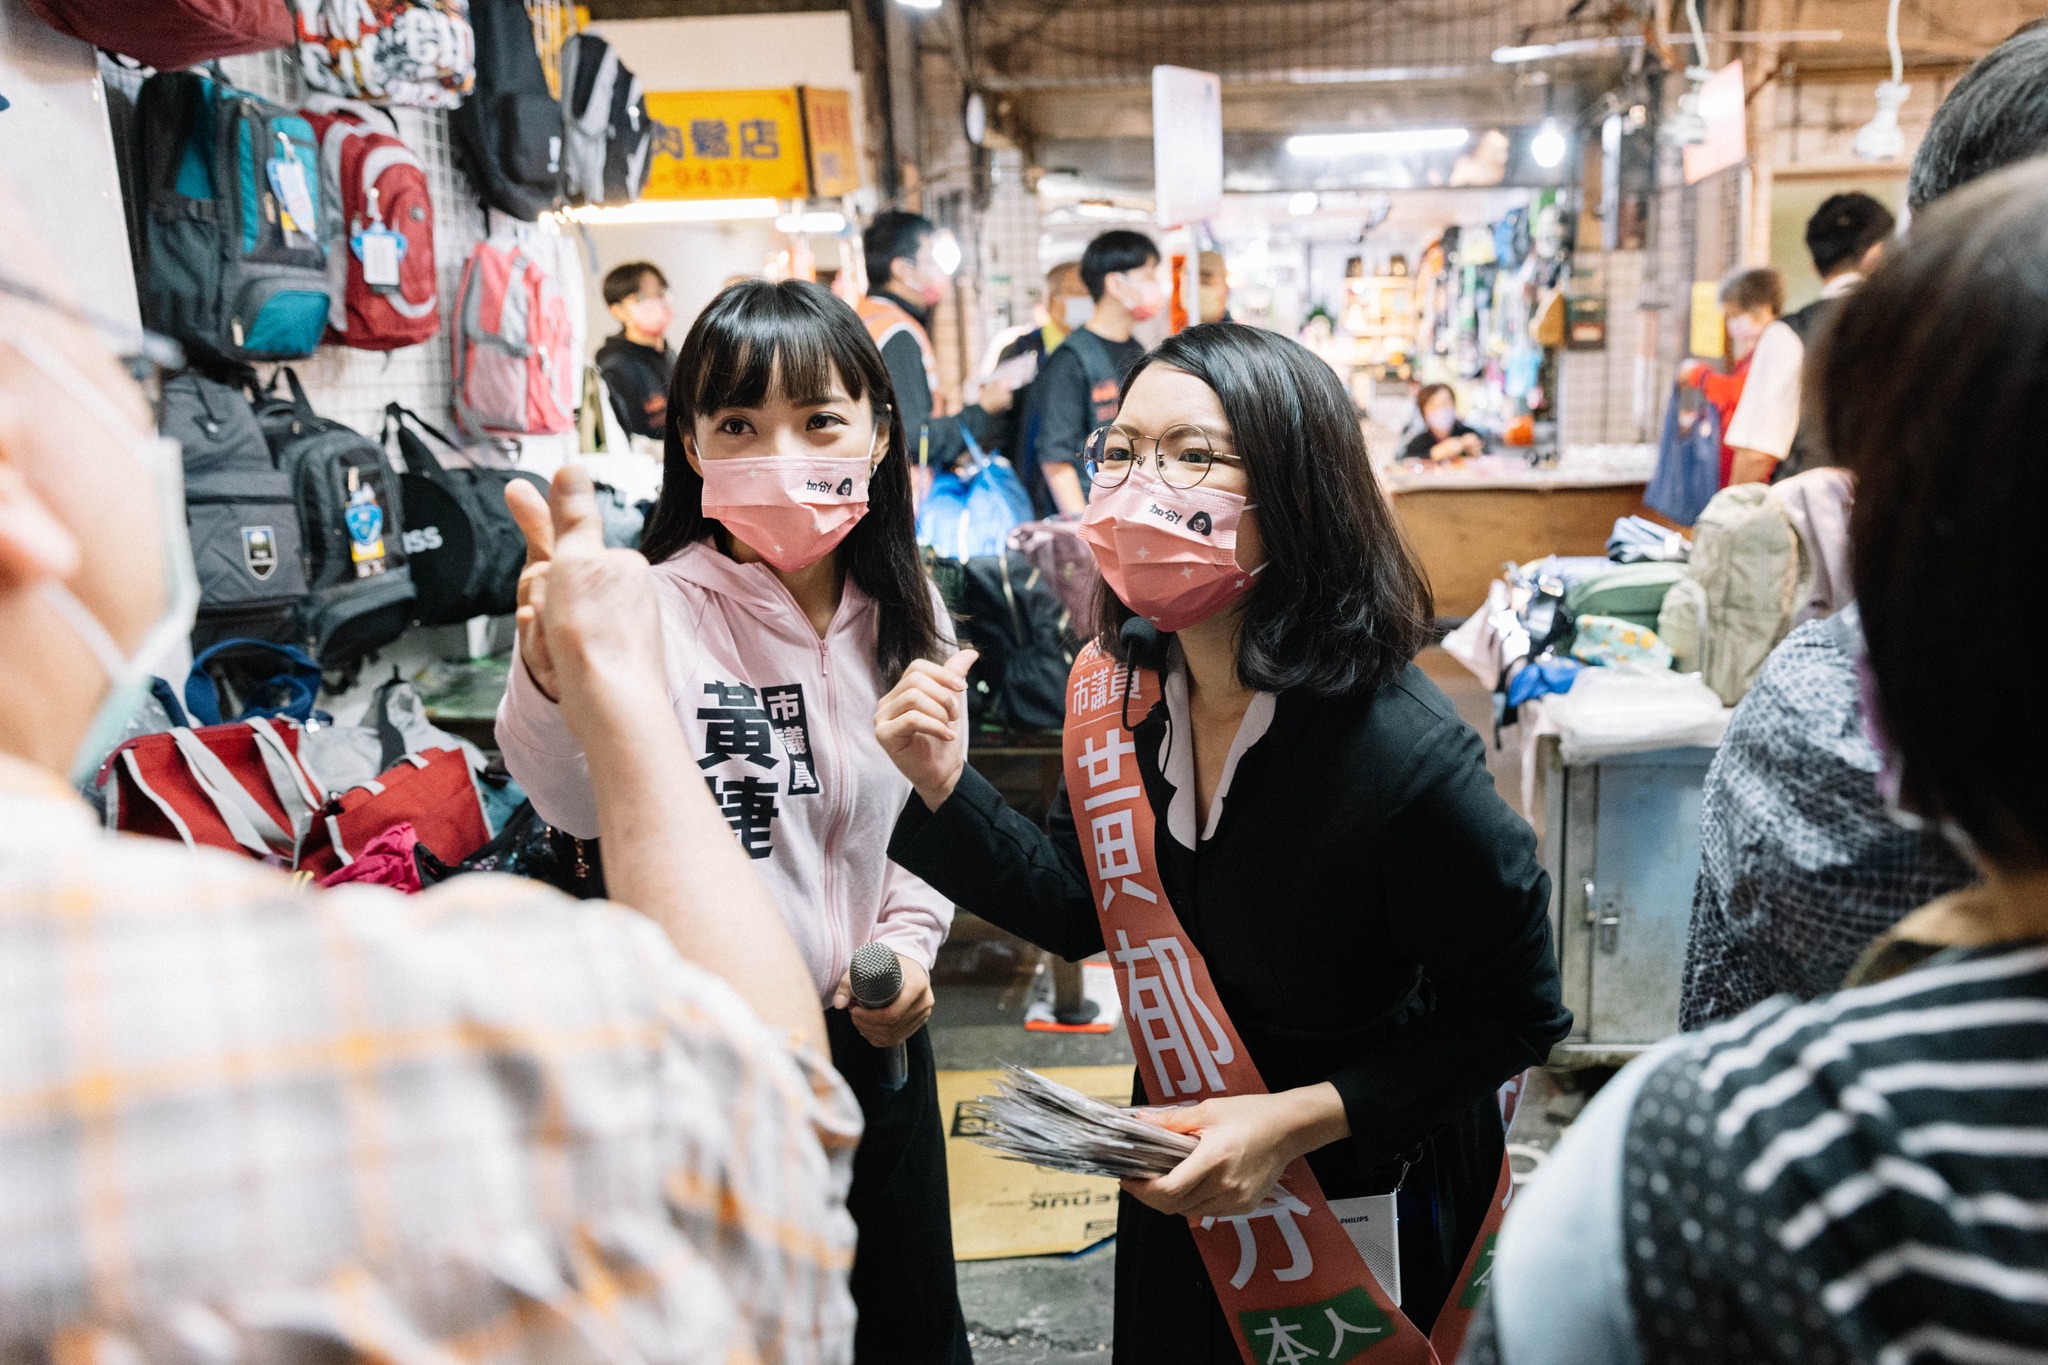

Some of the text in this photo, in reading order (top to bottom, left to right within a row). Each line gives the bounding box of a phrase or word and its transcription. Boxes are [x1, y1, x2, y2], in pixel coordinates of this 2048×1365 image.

[1072, 662, 1143, 716] 市議員
[765, 690, 817, 790] 市議員
[1340, 1215, 1369, 1224] PHILIPS
[1254, 1307, 1382, 1365] 本人
